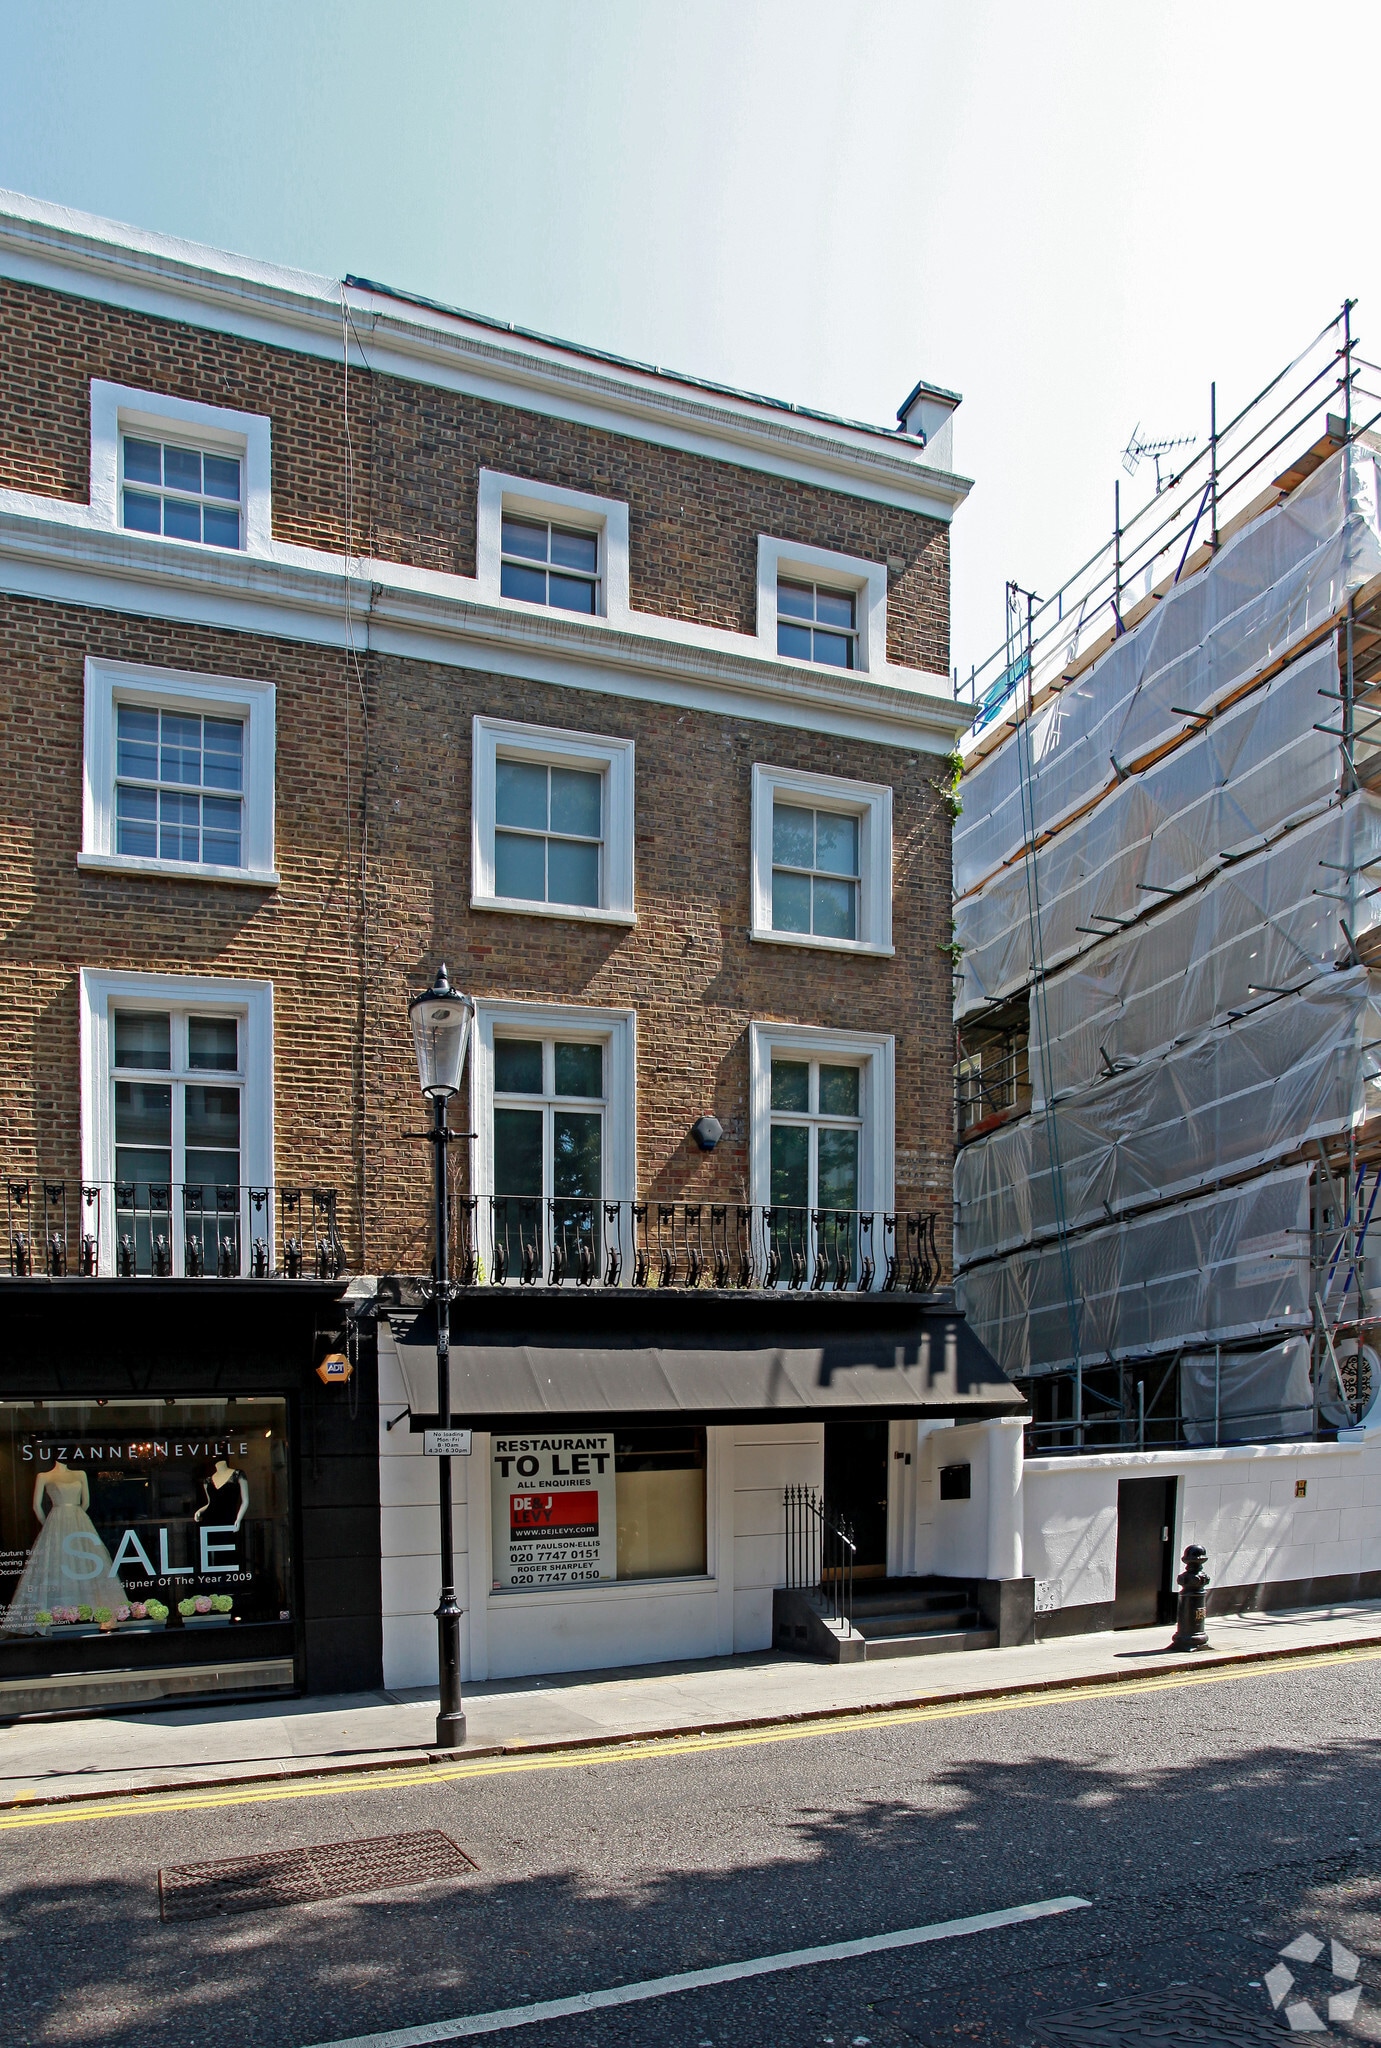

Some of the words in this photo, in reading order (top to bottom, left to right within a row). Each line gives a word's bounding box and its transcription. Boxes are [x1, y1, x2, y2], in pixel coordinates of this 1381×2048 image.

[327, 1363, 344, 1374] ADT
[22, 1444, 137, 1461] SUZANNE
[153, 1441, 248, 1457] NEVILLE
[496, 1438, 607, 1452] RESTAURANT
[494, 1455, 540, 1478] TO
[551, 1453, 610, 1476] LET
[517, 1481, 536, 1489] ALL
[539, 1479, 591, 1488] ENQUIRIES
[513, 1510, 553, 1524] LEVY
[61, 1525, 240, 1581] SALE
[509, 1544, 533, 1552] MATT
[536, 1540, 601, 1550] PAULSON-ELLIS
[510, 1553, 533, 1563] 020
[538, 1551, 567, 1561] 7747
[571, 1549, 599, 1559] 0151
[517, 1565, 547, 1573] ROGER
[549, 1562, 594, 1571] SHARPLEY
[158, 1577, 173, 1587] Of
[174, 1576, 195, 1585] The
[197, 1575, 222, 1585] Year
[226, 1572, 252, 1583] 2009
[510, 1575, 534, 1585] 020
[538, 1572, 567, 1583] 7747
[571, 1570, 600, 1581] 0150
